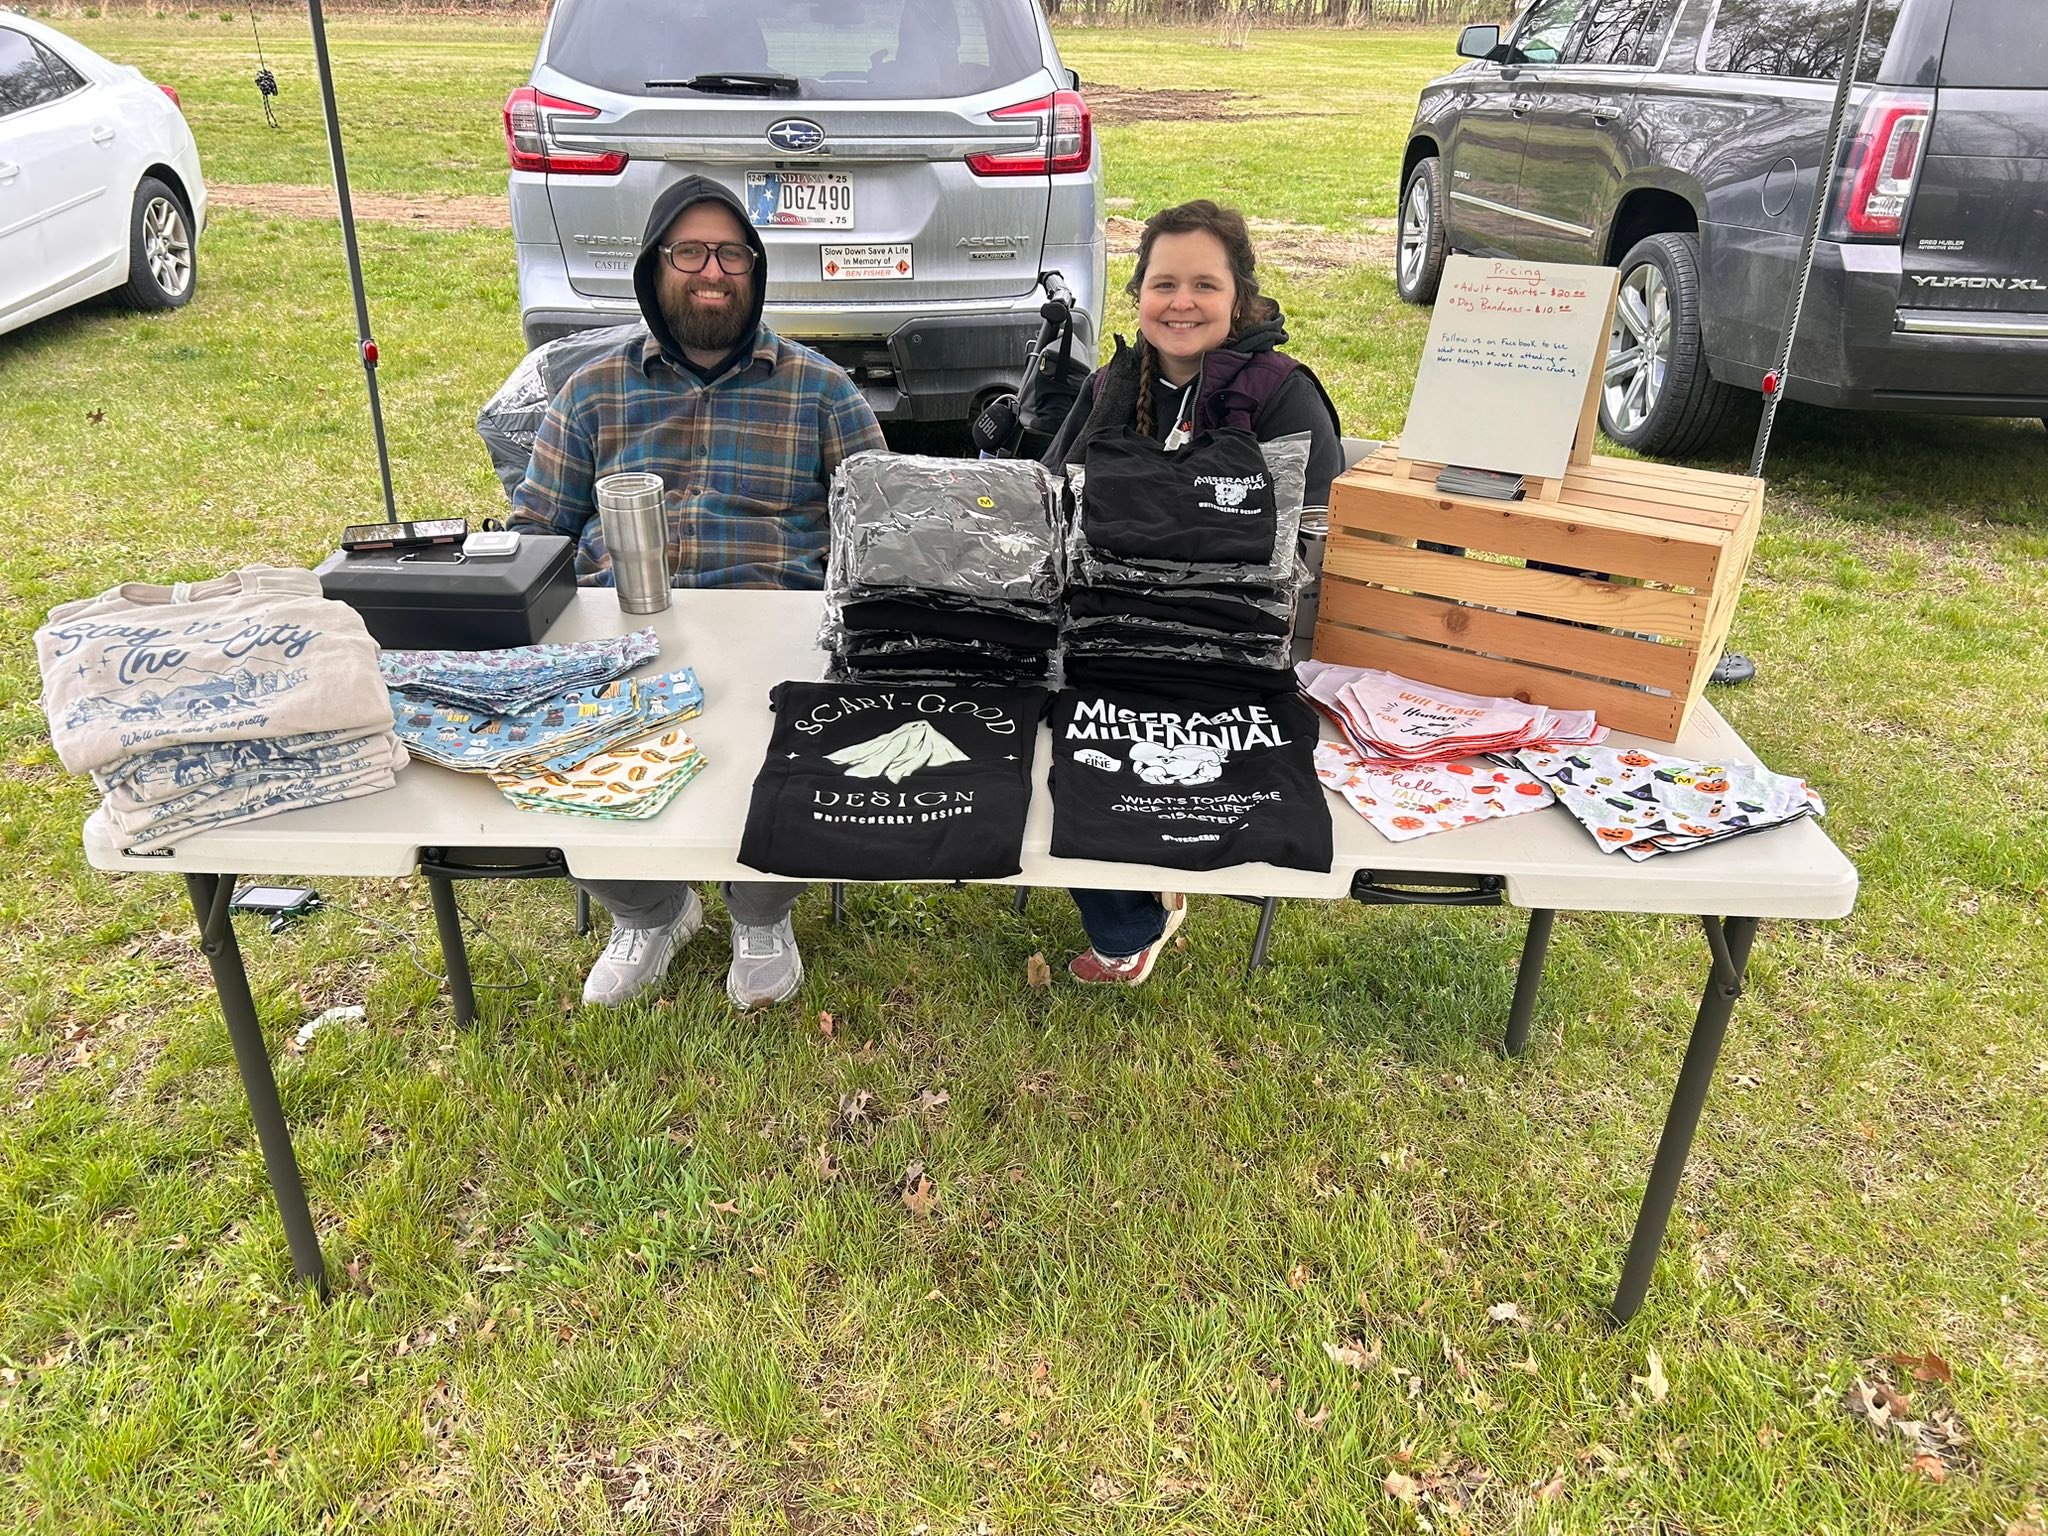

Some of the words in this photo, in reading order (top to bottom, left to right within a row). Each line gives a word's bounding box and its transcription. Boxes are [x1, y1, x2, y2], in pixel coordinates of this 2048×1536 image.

[775, 174, 824, 183] INDIANA
[836, 175, 847, 183] 25
[783, 185, 850, 210] DGZ490
[836, 216, 847, 224] 75
[956, 235, 1029, 248] ASCENT
[824, 248, 843, 256] Slow
[844, 247, 866, 255] Down
[867, 247, 886, 255] Save
[895, 246, 909, 254] Life
[594, 260, 630, 270] CASTLE
[852, 257, 882, 266] Memory
[863, 269, 891, 277] FISHER
[1493, 263, 1542, 286] Pricing
[1460, 282, 1490, 293] Adult
[1911, 275, 2006, 289] YUKON
[2007, 279, 2048, 290] XL
[1458, 297, 1474, 312] Dog
[1442, 333, 1467, 343] Follow
[1501, 338, 1536, 348] Facebook
[1542, 340, 1549, 348] to
[1554, 342, 1568, 350] see
[978, 413, 997, 440] JBL
[49, 623, 173, 657] Stay
[182, 621, 222, 636] in
[103, 643, 191, 685] The
[203, 622, 323, 659] City
[1399, 692, 1432, 706] Will
[1436, 703, 1486, 717] Trade
[794, 693, 1017, 736] SCARY-GOOD
[1073, 698, 1273, 731] MISERABLE
[1402, 707, 1457, 721] Human
[1065, 721, 1293, 751] MILLENNIAL
[1387, 773, 1449, 796] hello
[813, 790, 975, 808] DESIGN
[1120, 794, 1188, 805] WHAT'S
[1392, 788, 1425, 803] FALL
[921, 805, 973, 823] DESIGN
